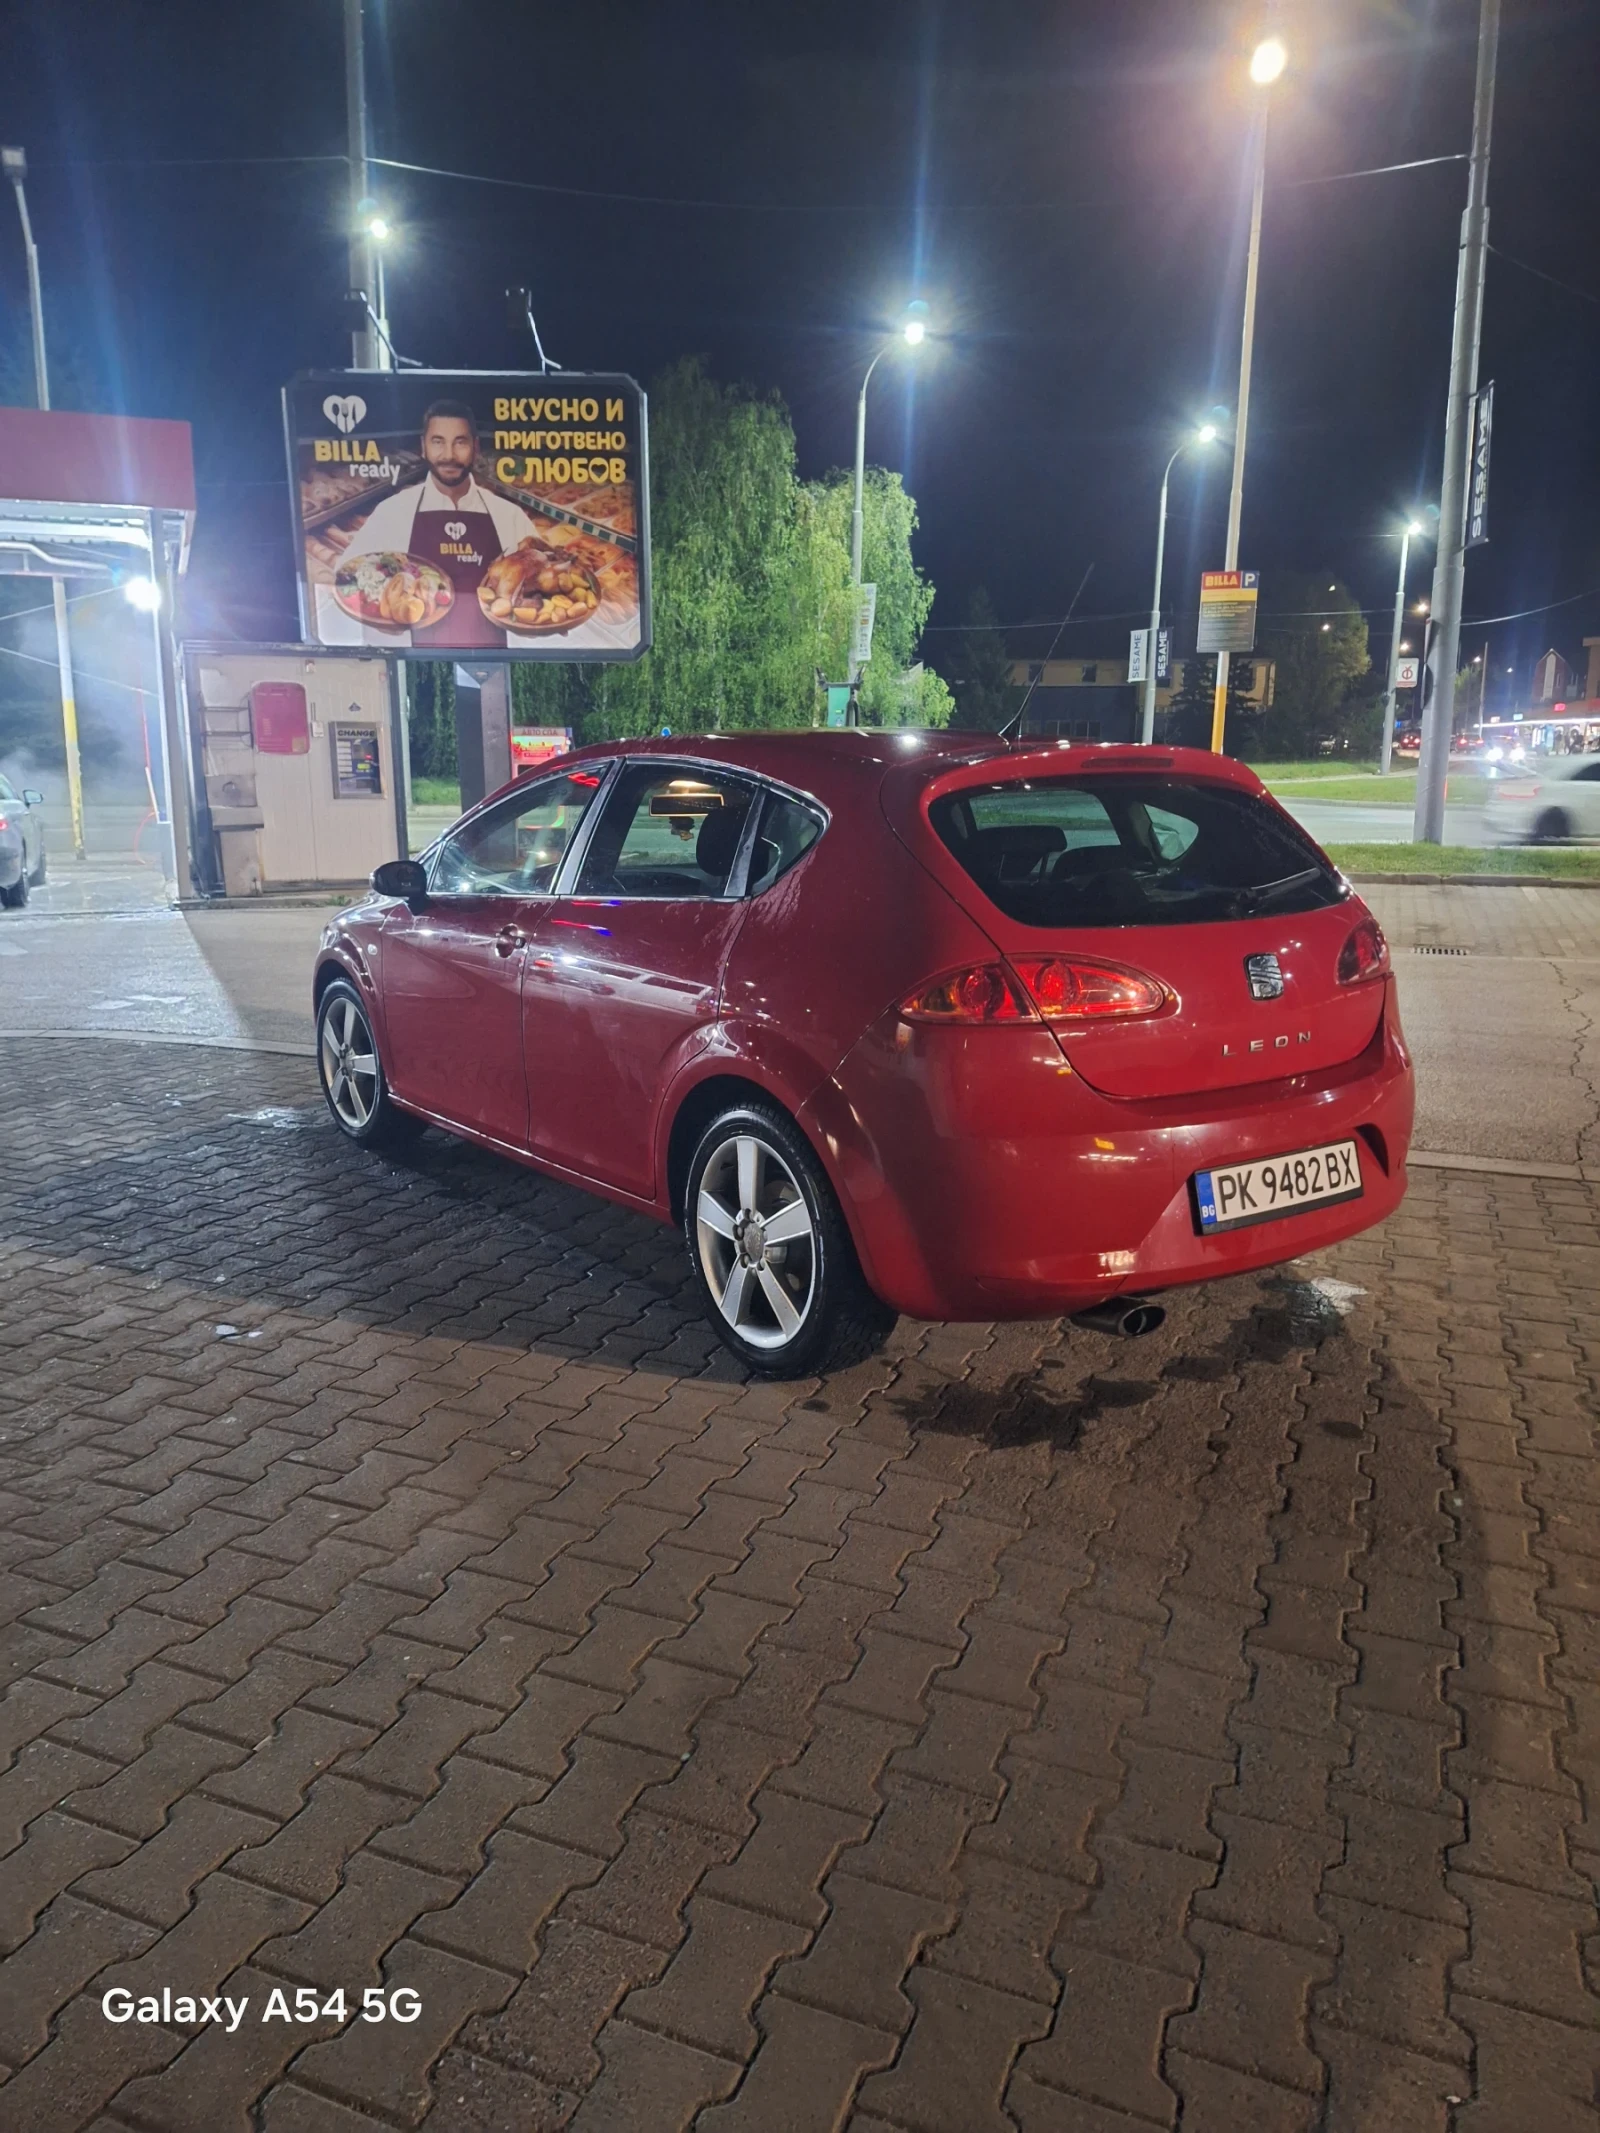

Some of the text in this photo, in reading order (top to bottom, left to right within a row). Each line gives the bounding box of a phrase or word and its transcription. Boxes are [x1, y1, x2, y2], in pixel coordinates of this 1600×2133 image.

[494, 397, 624, 422] ВКУСНО И
[314, 440, 381, 462] BILLA
[494, 430, 626, 450] ПРИГОТВЕНО
[349, 455, 400, 486] ready
[496, 457, 626, 484] С ЛЮБОВ
[1472, 398, 1489, 538] SESAME
[440, 543, 473, 555] BILLA
[457, 551, 483, 566] ready
[1205, 574, 1238, 587] BILLA
[1132, 633, 1141, 678] SESAME
[1157, 630, 1168, 677] SESAME
[337, 729, 376, 737] CHANGE
[1222, 1030, 1311, 1056] LEON
[1201, 1204, 1216, 1218] BG
